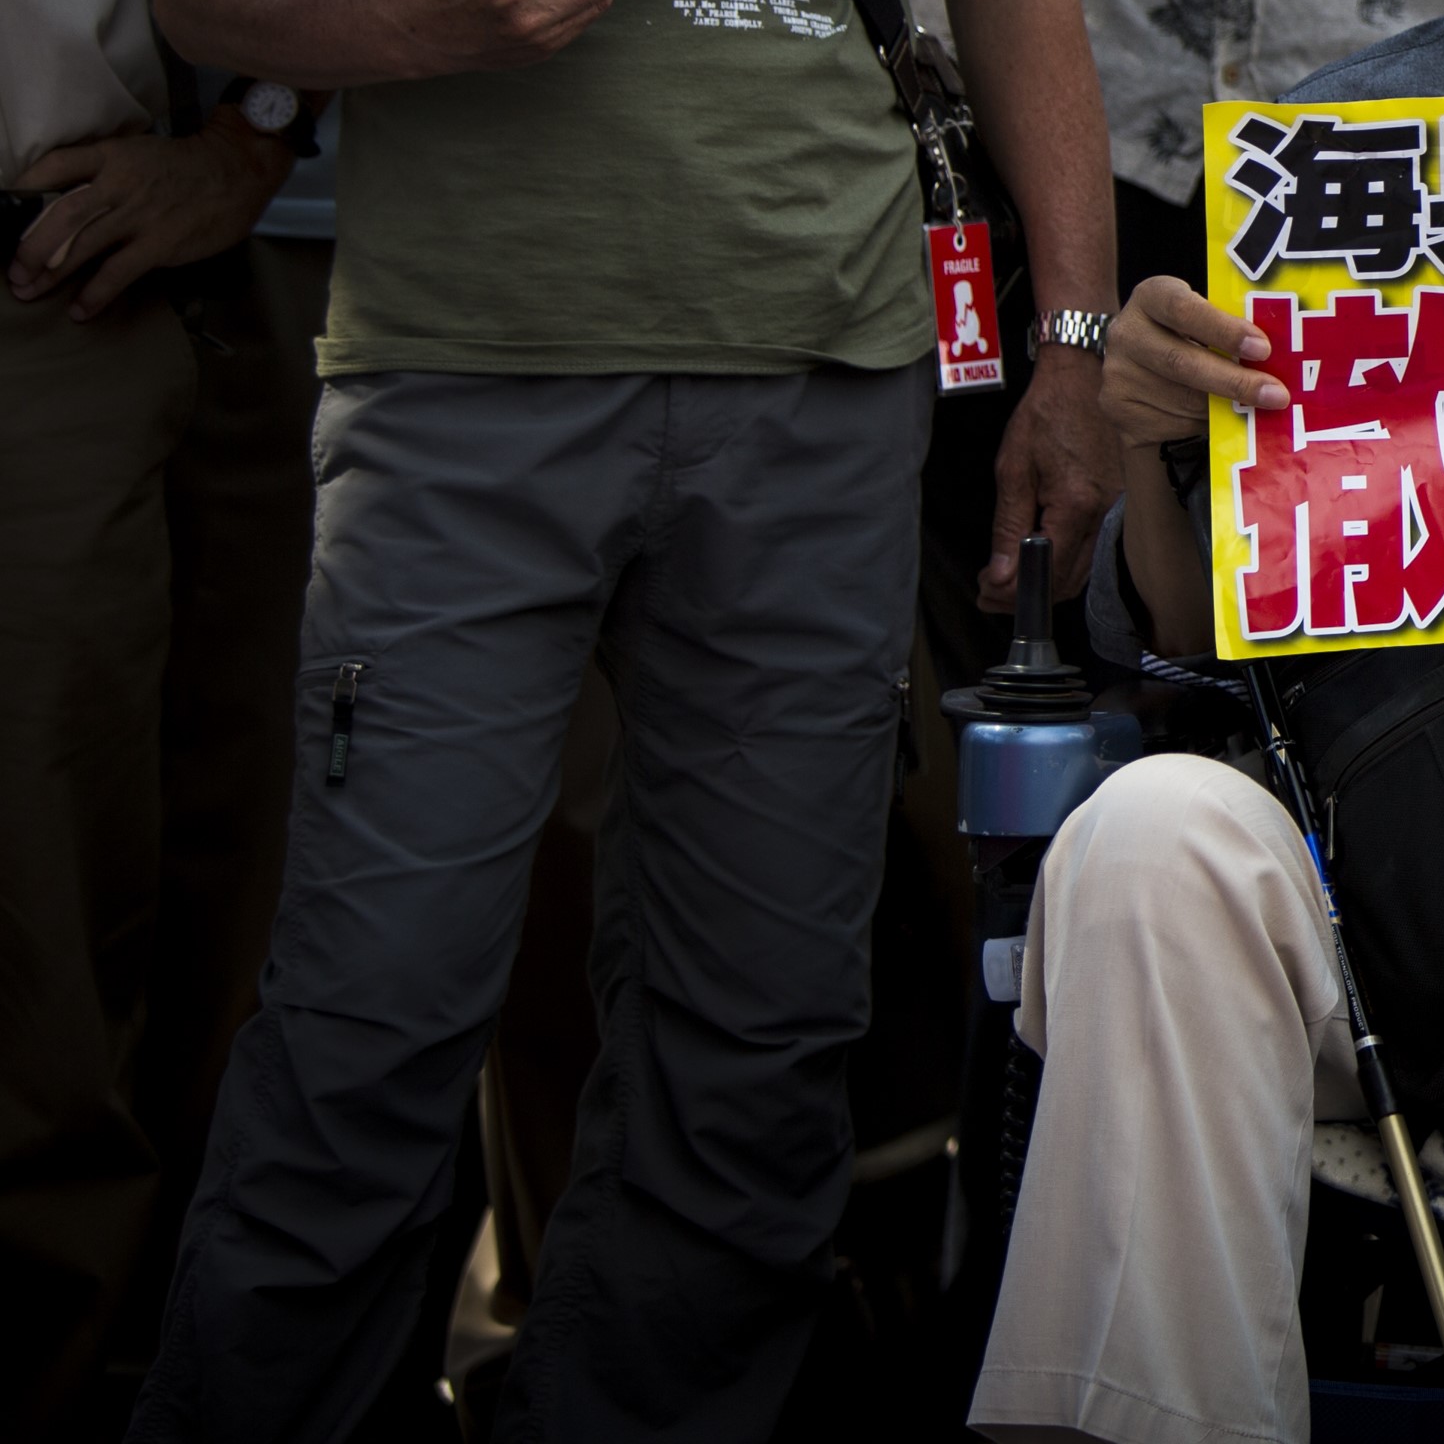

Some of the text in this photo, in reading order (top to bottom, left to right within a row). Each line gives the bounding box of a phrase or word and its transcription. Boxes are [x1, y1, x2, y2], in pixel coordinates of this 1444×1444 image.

[943, 257, 981, 276] FRAGILE
[964, 363, 998, 382] NUKES
[333, 738, 345, 771] AIGLE
[1336, 945, 1354, 995] TECHNOLOGY
[1351, 996, 1365, 1032] PRODUCT
